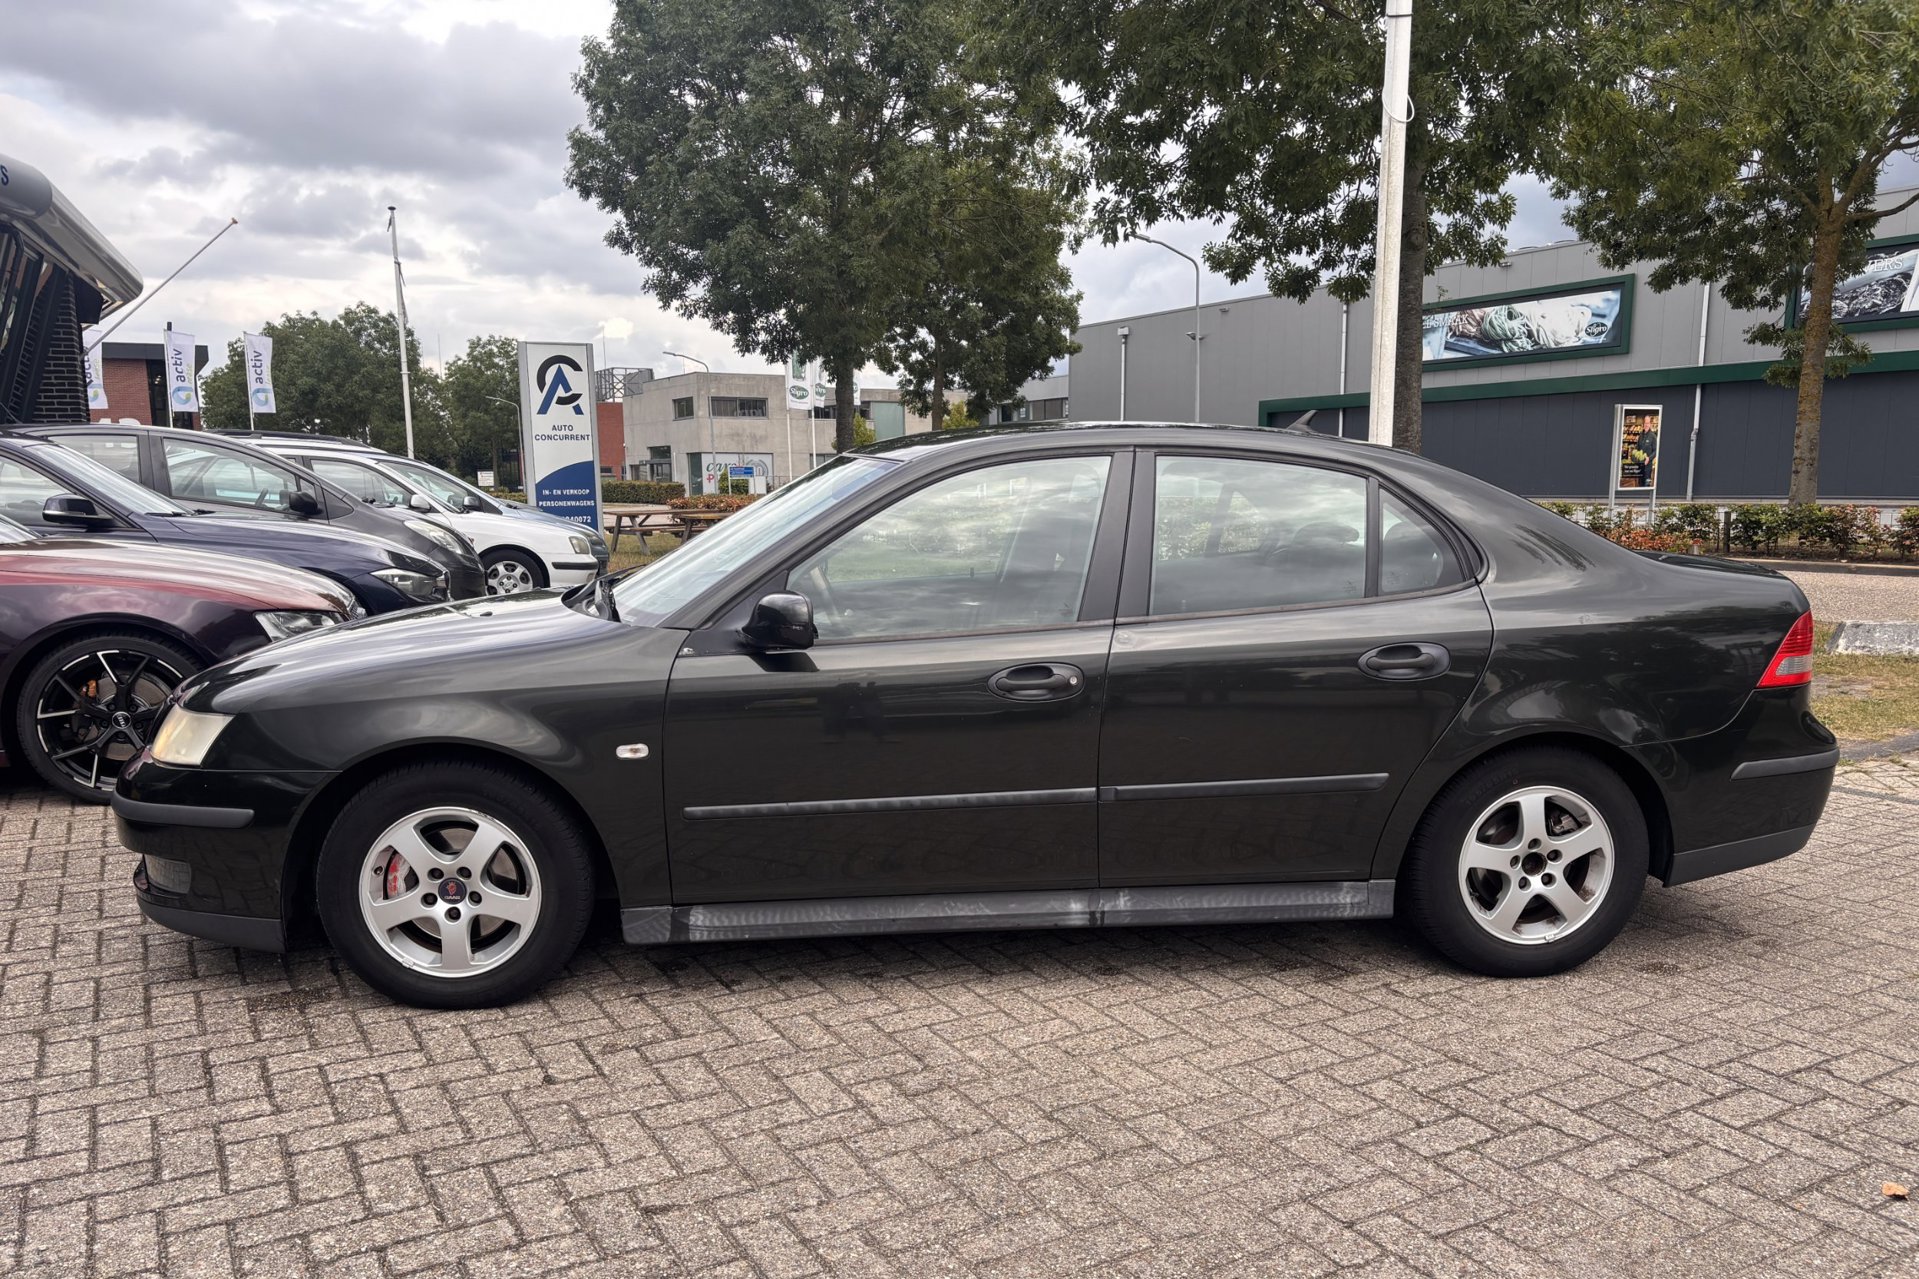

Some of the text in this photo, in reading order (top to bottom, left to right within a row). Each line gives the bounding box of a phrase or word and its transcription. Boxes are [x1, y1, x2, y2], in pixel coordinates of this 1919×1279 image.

[171, 348, 186, 383] activ
[250, 350, 263, 385] activ
[551, 424, 574, 432] AUTO
[534, 433, 591, 441] CONCURRENT
[562, 488, 590, 496] VERKOOP
